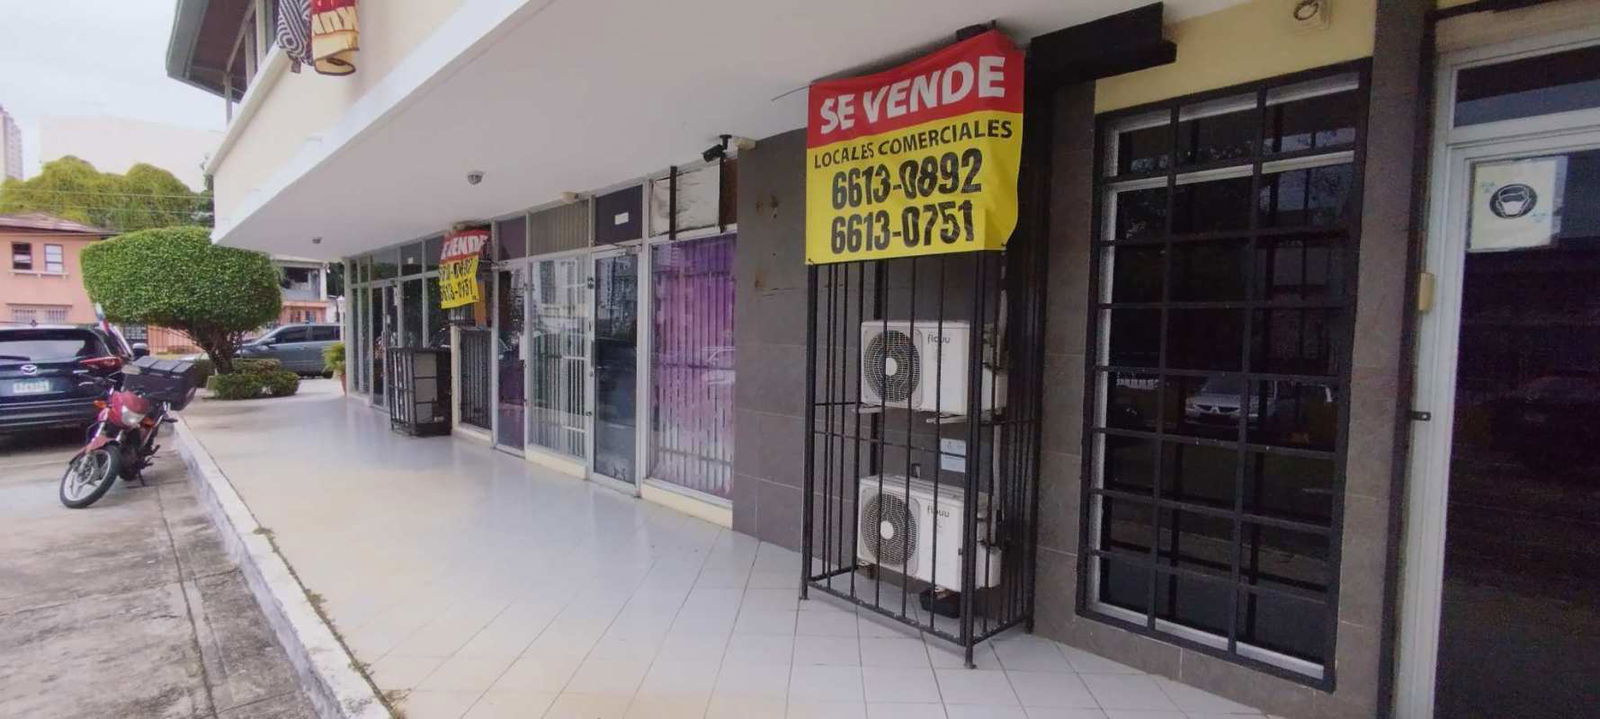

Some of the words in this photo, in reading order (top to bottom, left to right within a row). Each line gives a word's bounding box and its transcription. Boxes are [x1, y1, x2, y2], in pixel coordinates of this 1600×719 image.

[820, 93, 856, 135] SE
[862, 55, 1006, 124] VENDE
[814, 142, 874, 169] LOCALES
[878, 120, 1013, 156] COMERCIALES
[832, 148, 983, 210] 6613-0892
[831, 200, 974, 254] 6613-0751
